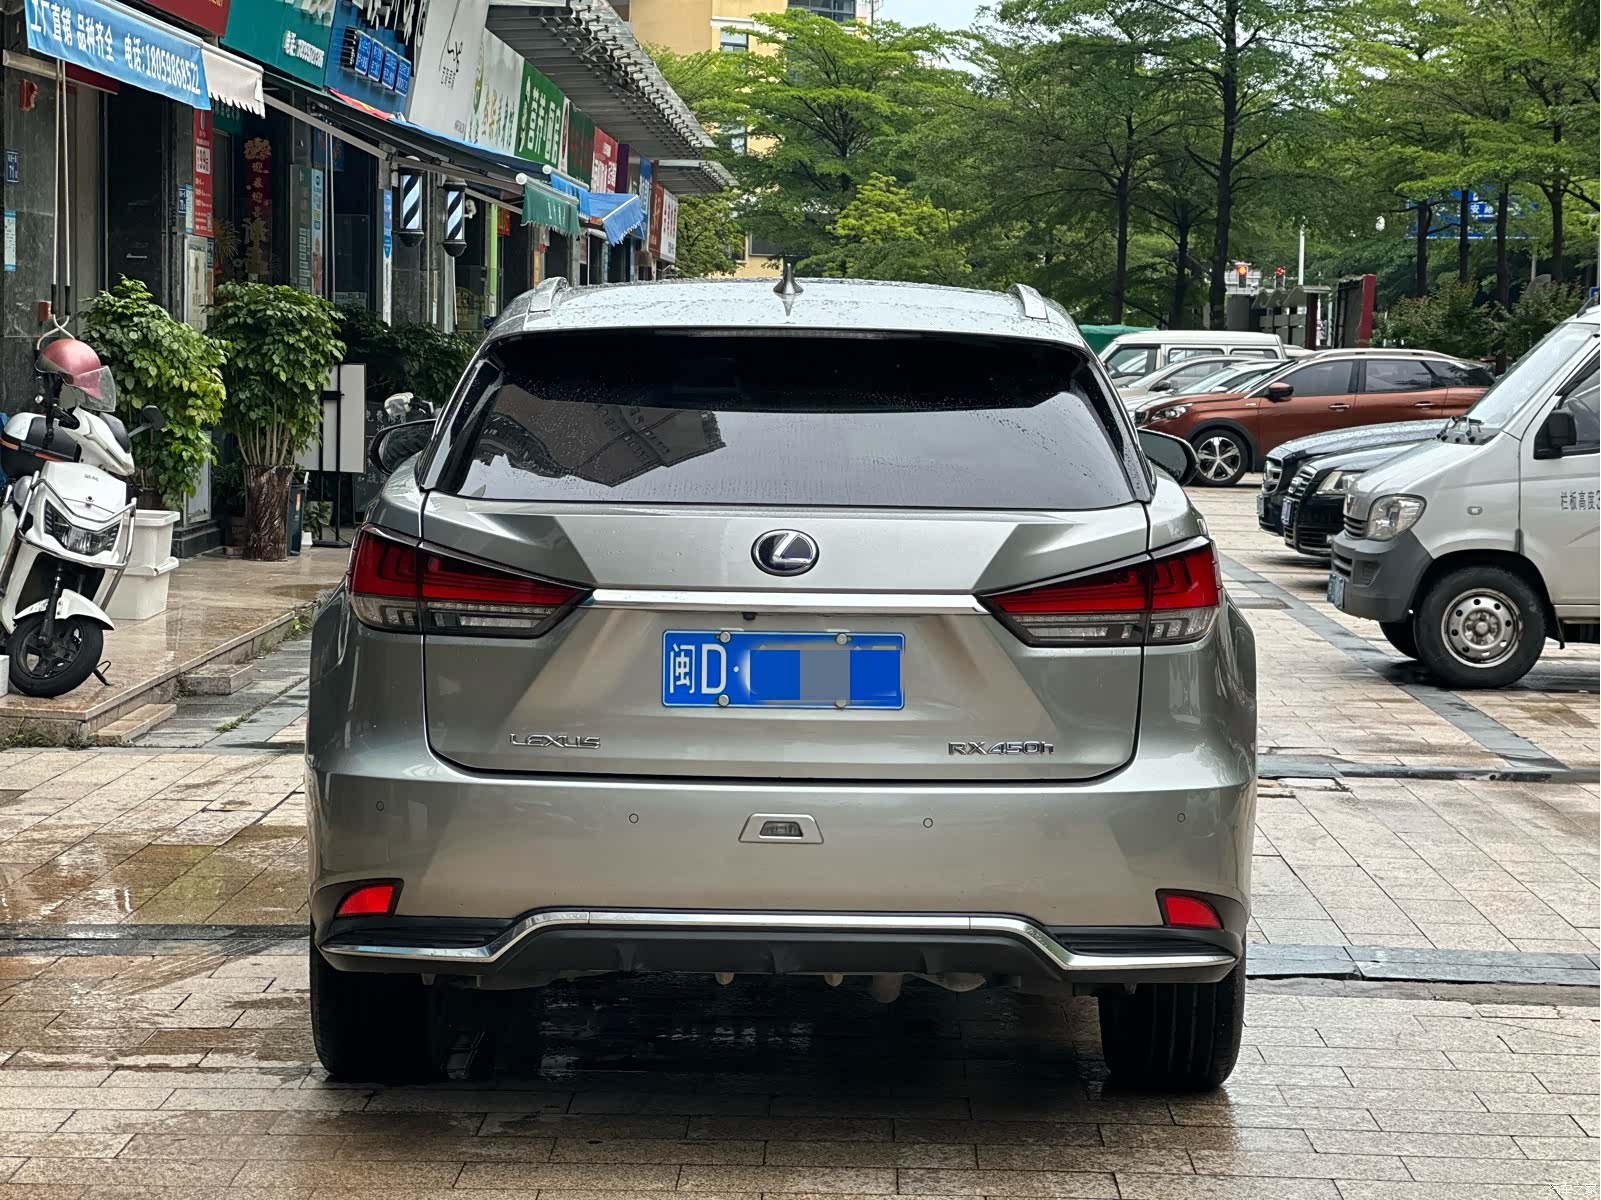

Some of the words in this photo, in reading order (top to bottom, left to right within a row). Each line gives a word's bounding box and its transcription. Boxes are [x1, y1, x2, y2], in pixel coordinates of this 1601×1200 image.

[31, 0, 73, 46] 工厂直销
[77, 13, 115, 64] 品种齐全
[510, 733, 600, 749] LEXUS
[948, 741, 1054, 755] RX450h
